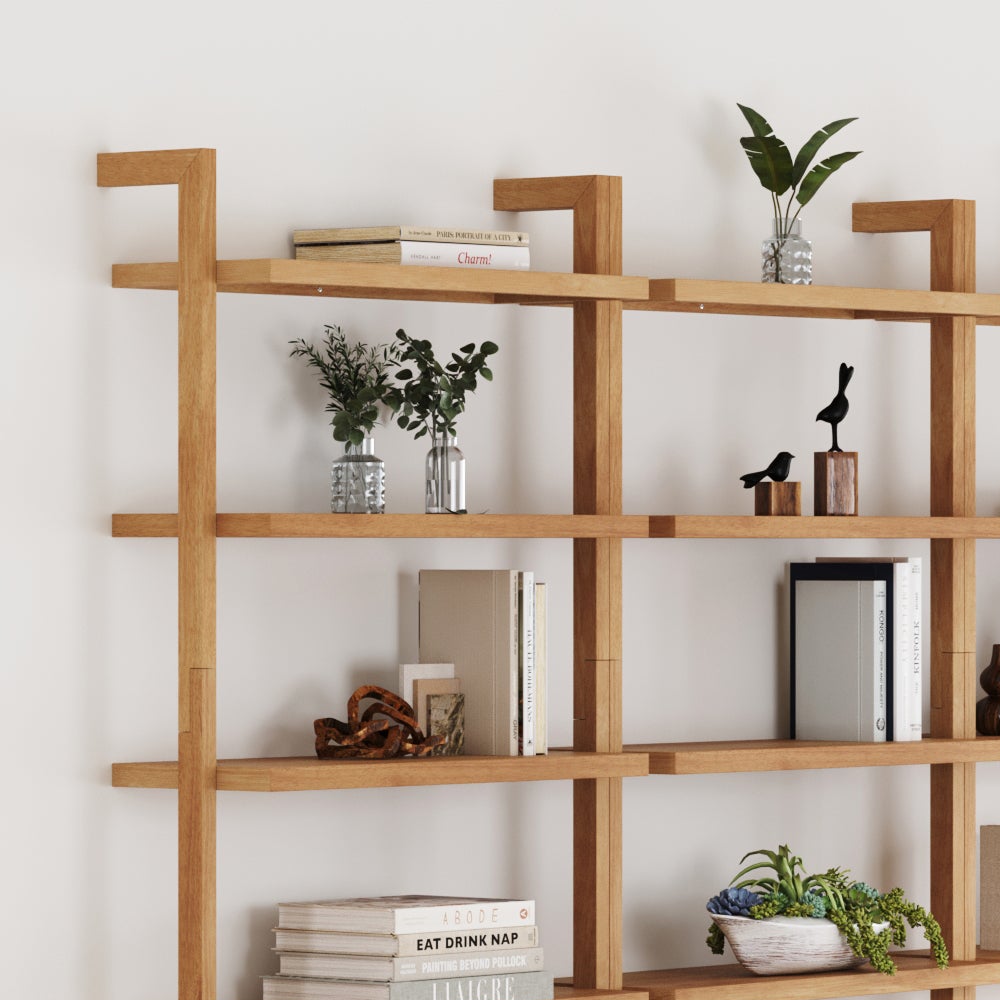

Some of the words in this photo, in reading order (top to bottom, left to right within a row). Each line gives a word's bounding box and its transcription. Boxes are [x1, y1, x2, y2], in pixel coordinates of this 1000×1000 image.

[457, 251, 492, 265] Charm!
[442, 908, 499, 925] ABODE
[416, 938, 441, 951] EAT
[445, 935, 487, 949] DRINK
[491, 932, 519, 945] NAP
[421, 960, 458, 974] PAINTING
[459, 957, 490, 971] BEYOND
[492, 954, 528, 969] POLLOCK
